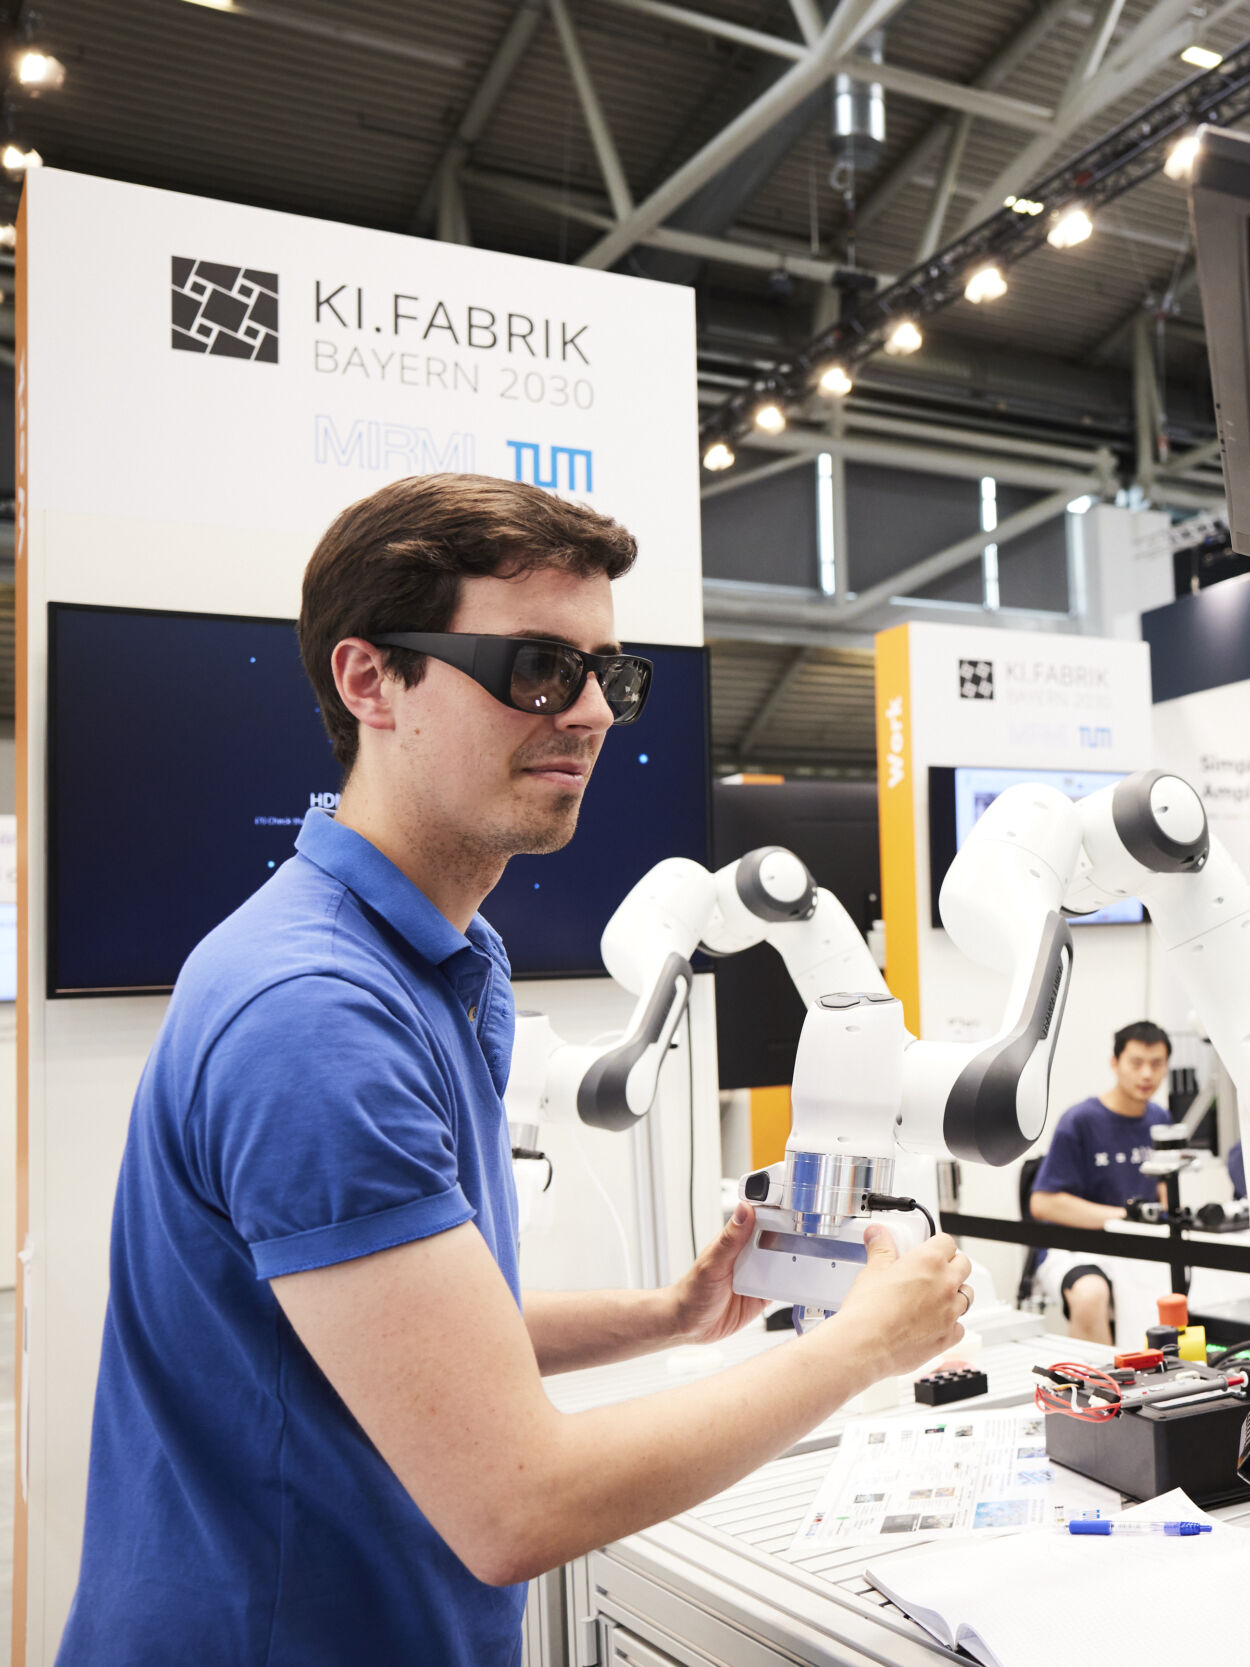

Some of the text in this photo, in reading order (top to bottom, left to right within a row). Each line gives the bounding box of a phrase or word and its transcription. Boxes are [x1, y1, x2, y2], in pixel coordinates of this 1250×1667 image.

[315, 280, 590, 366] KI.FABRIK
[314, 339, 594, 411] BAYERN 2030
[506, 439, 592, 493] TUM
[886, 696, 905, 790] Work
